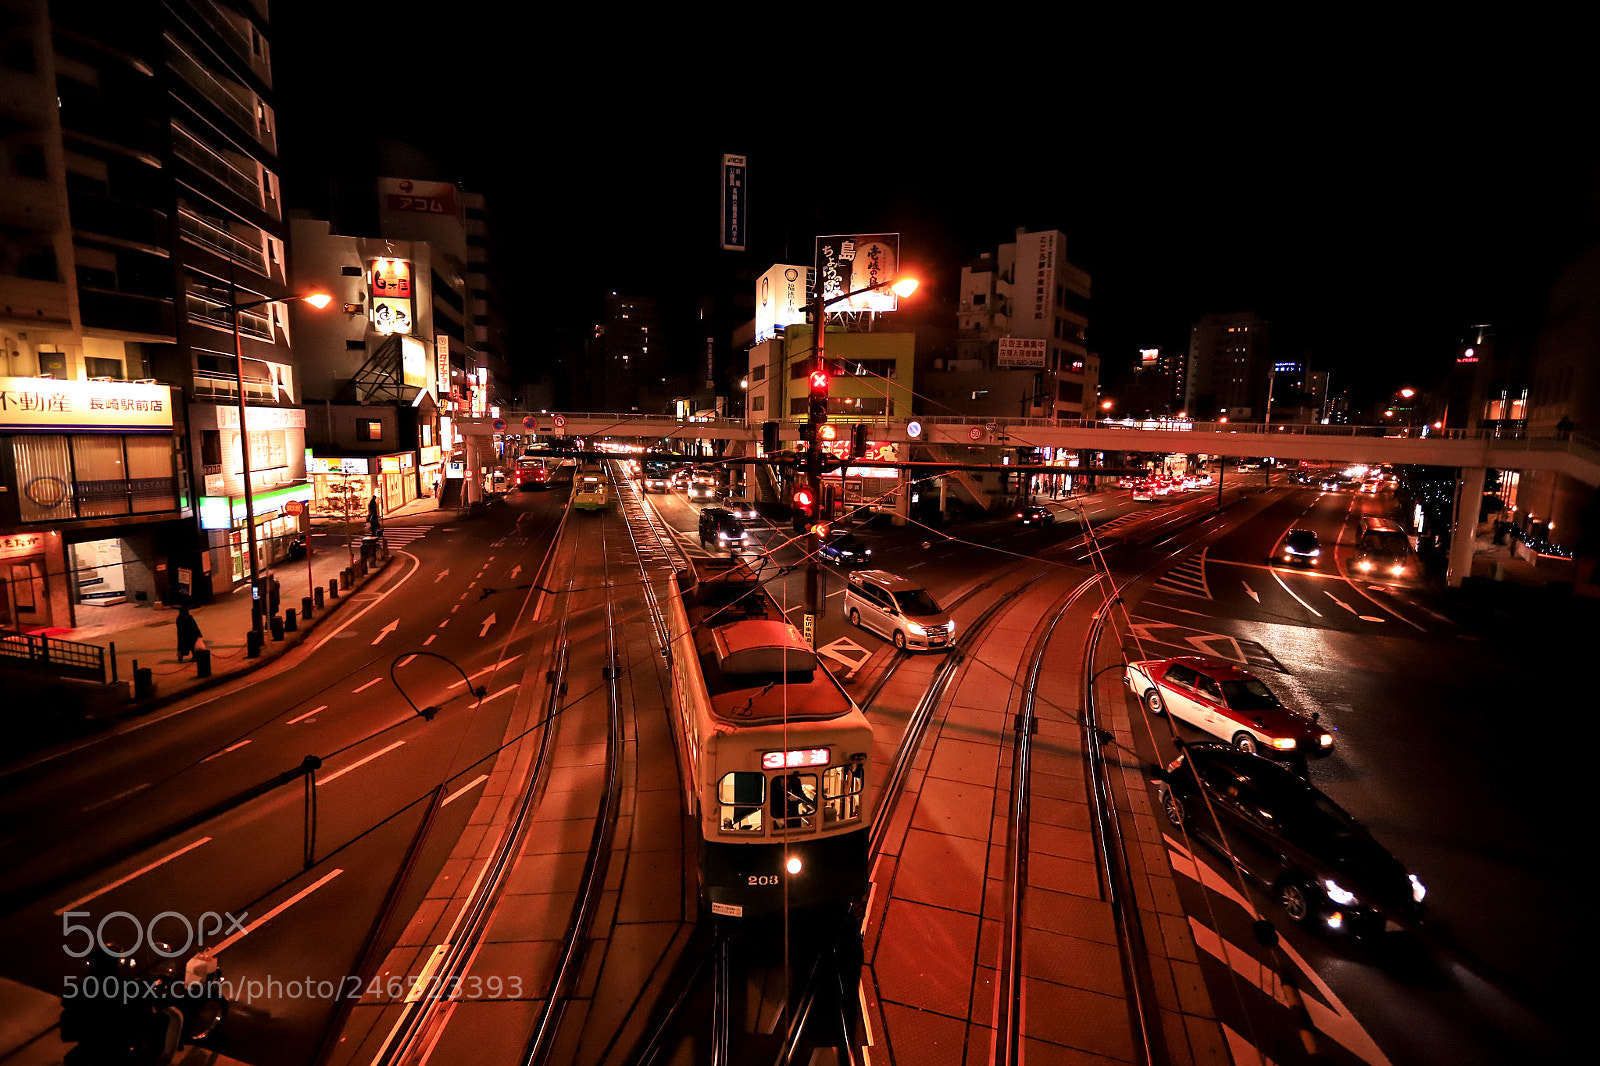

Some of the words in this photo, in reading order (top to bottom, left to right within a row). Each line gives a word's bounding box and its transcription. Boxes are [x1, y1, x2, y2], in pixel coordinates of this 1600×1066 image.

[399, 197, 443, 212] アコム
[838, 240, 856, 262] 島
[439, 354, 449, 391] タナチョー
[89, 397, 163, 412] 長崎駅前店
[763, 752, 785, 767] 3
[748, 875, 779, 886] 203
